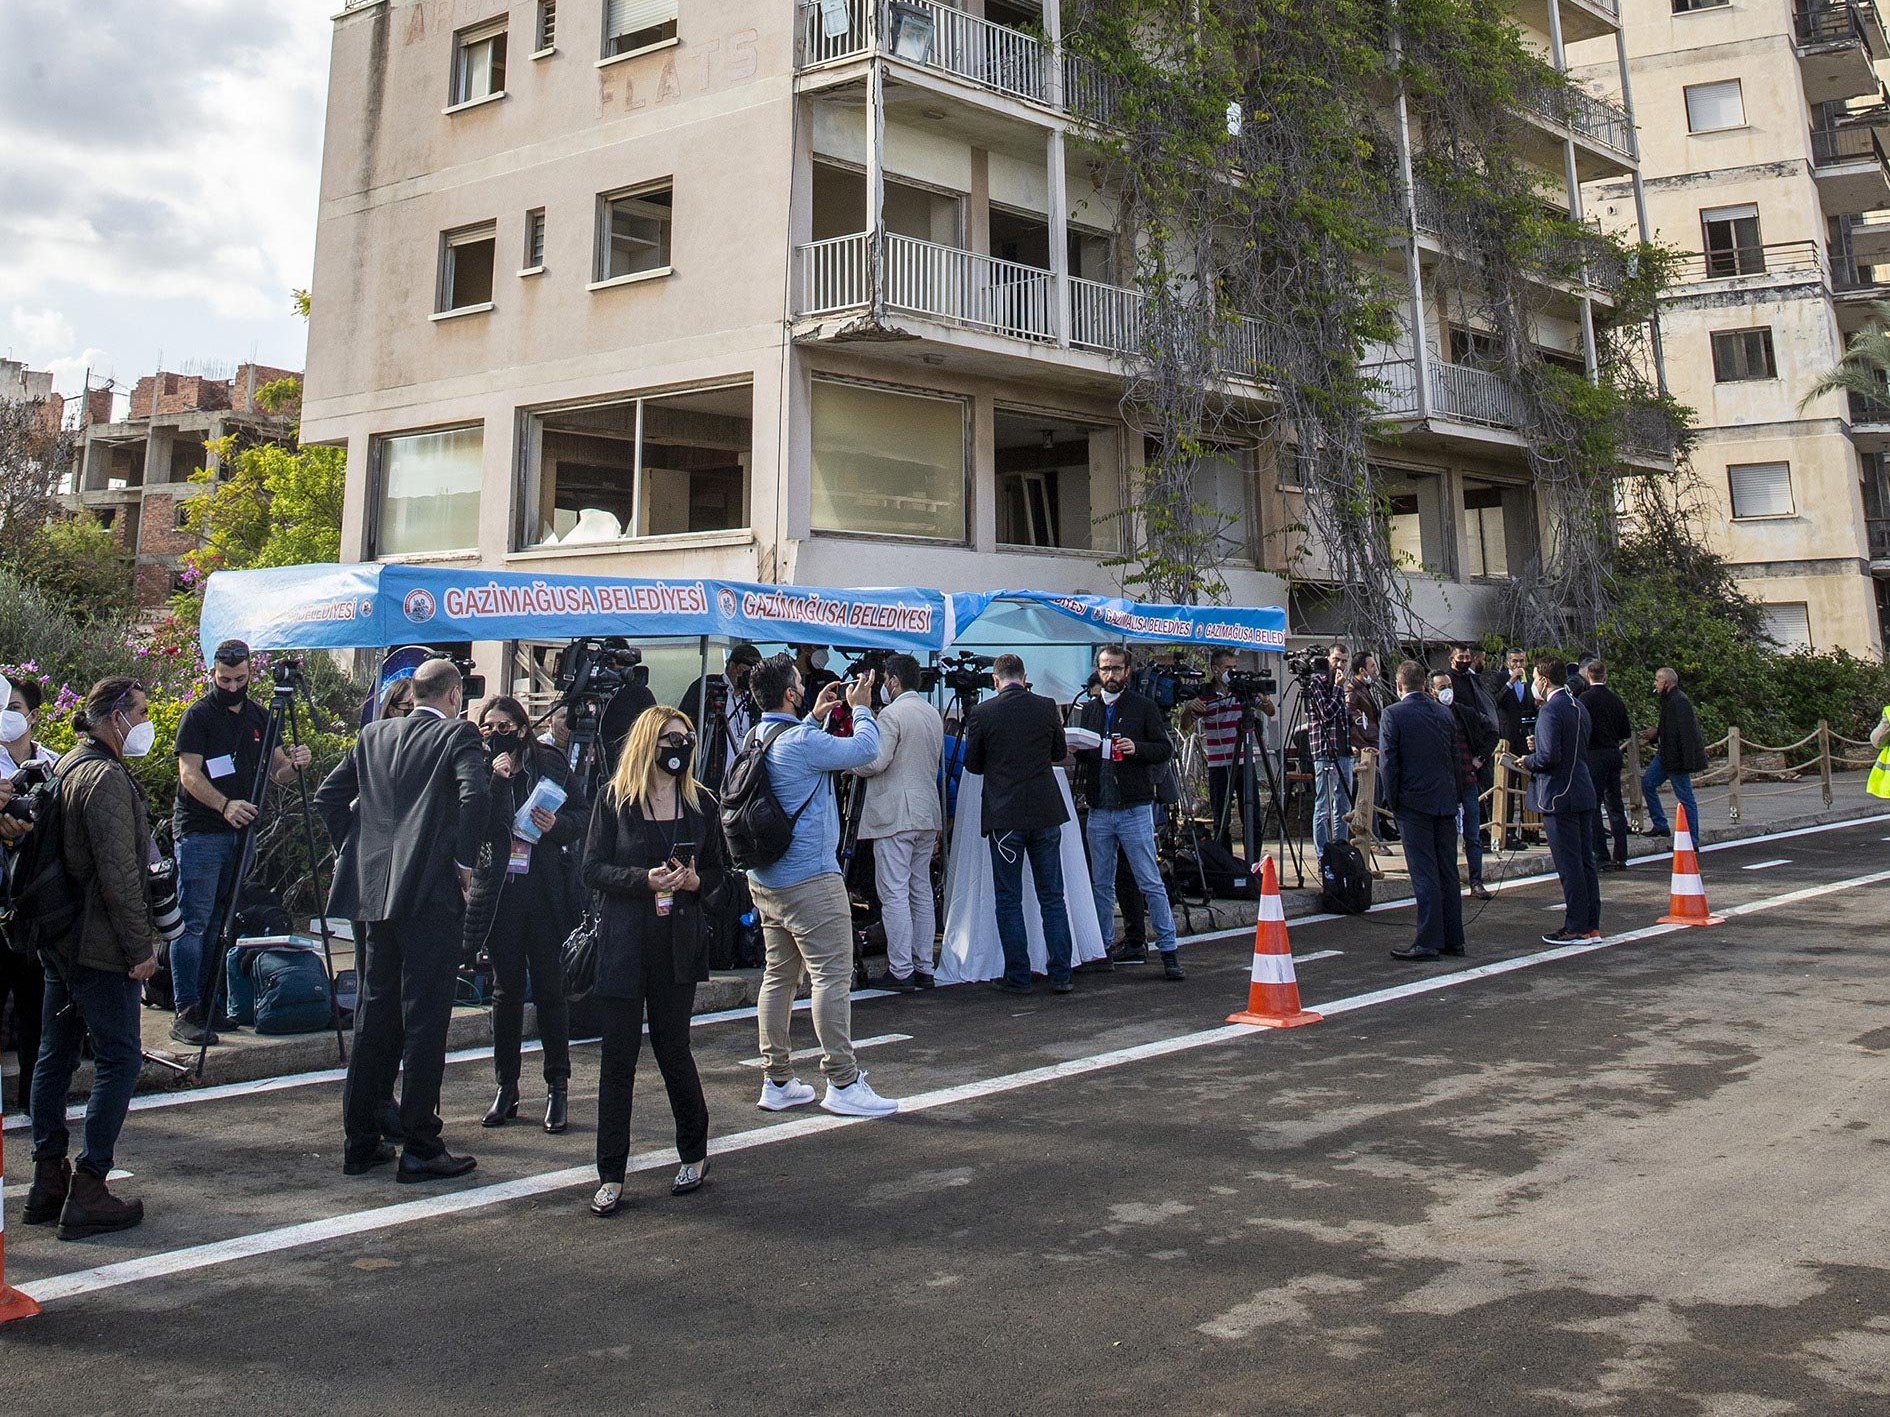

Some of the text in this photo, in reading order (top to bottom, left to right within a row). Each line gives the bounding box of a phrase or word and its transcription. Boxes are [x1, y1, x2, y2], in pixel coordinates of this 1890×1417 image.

[596, 28, 758, 119] FLATS
[446, 583, 595, 615] GAZİMAĞUSA
[597, 583, 706, 612] BELEDİYESİ
[744, 592, 931, 632] GAZİMAĞUSA BELEDİYESİ
[1149, 618, 1192, 636] BELEDİYESİ
[1205, 623, 1253, 641] GAZİMAĞUSA
